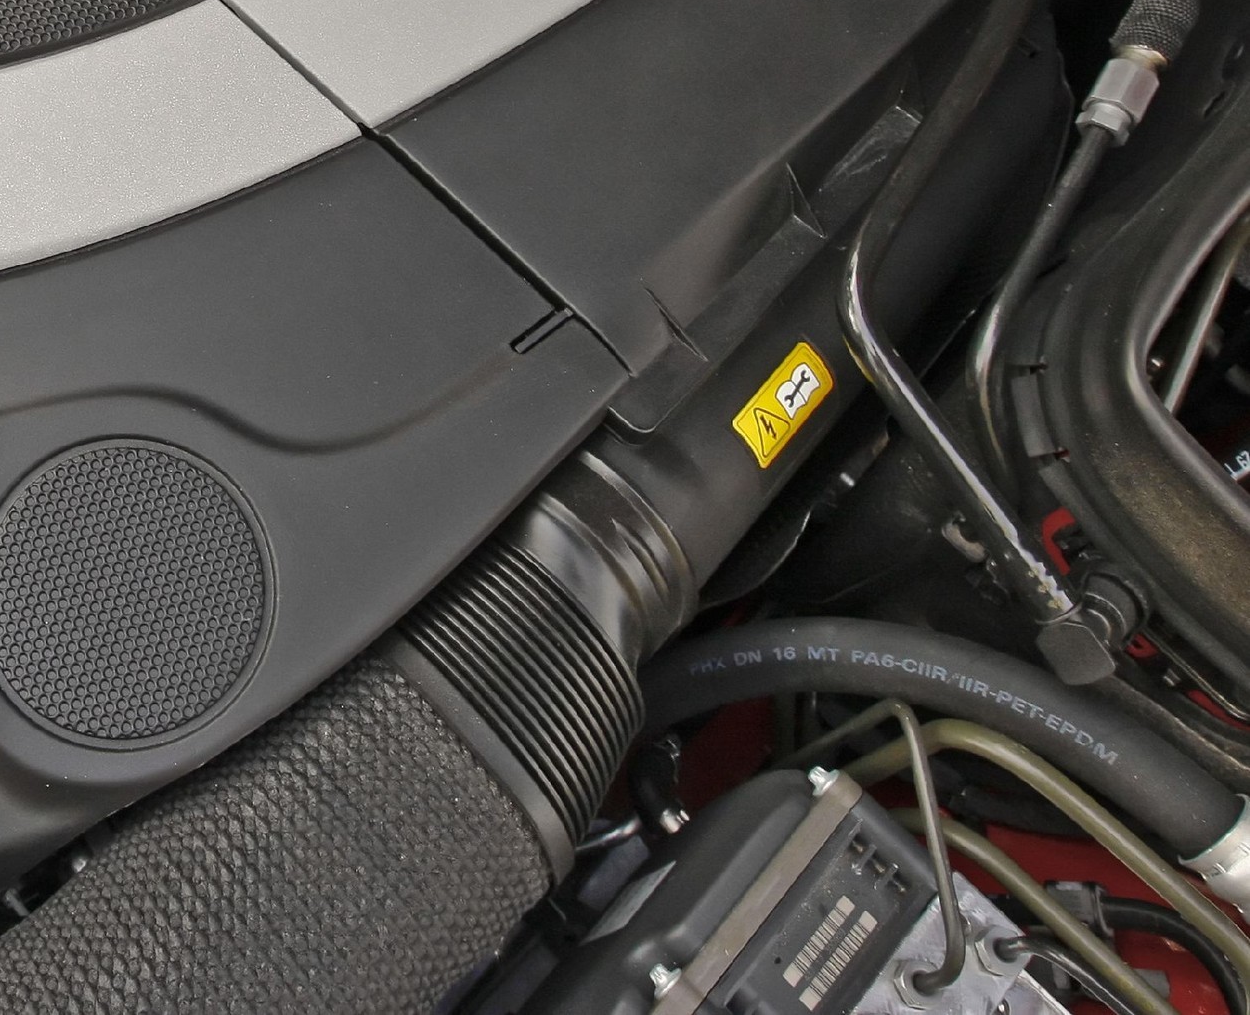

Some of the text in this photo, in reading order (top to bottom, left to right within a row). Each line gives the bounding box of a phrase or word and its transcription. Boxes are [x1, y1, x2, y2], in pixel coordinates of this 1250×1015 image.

[733, 649, 763, 667] DN
[772, 646, 797, 662] 16
[806, 645, 841, 662] MT
